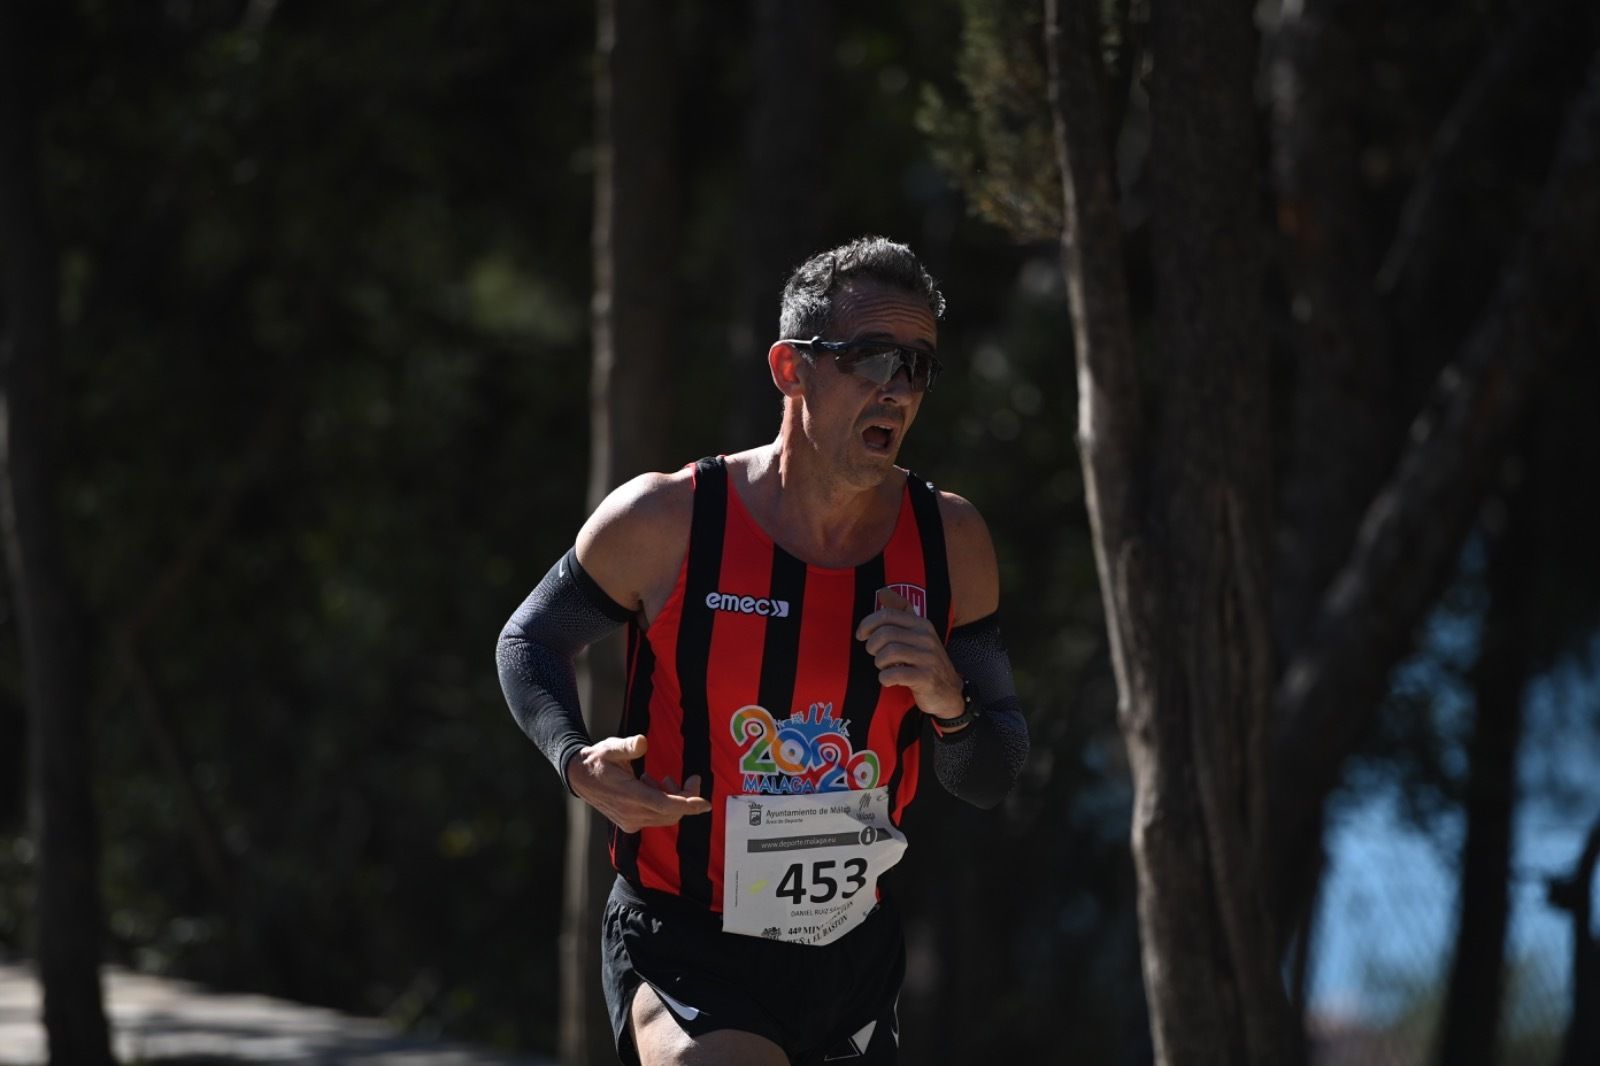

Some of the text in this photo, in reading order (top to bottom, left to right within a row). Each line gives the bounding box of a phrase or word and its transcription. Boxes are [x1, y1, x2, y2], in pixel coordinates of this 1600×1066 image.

[706, 592, 770, 616] emec
[766, 808, 817, 818] Ayuntamiento
[819, 807, 828, 815] de
[760, 836, 837, 849] www.deporte.malaga.eu
[776, 857, 868, 905] 453
[791, 907, 829, 917] DANIEL RUIZ
